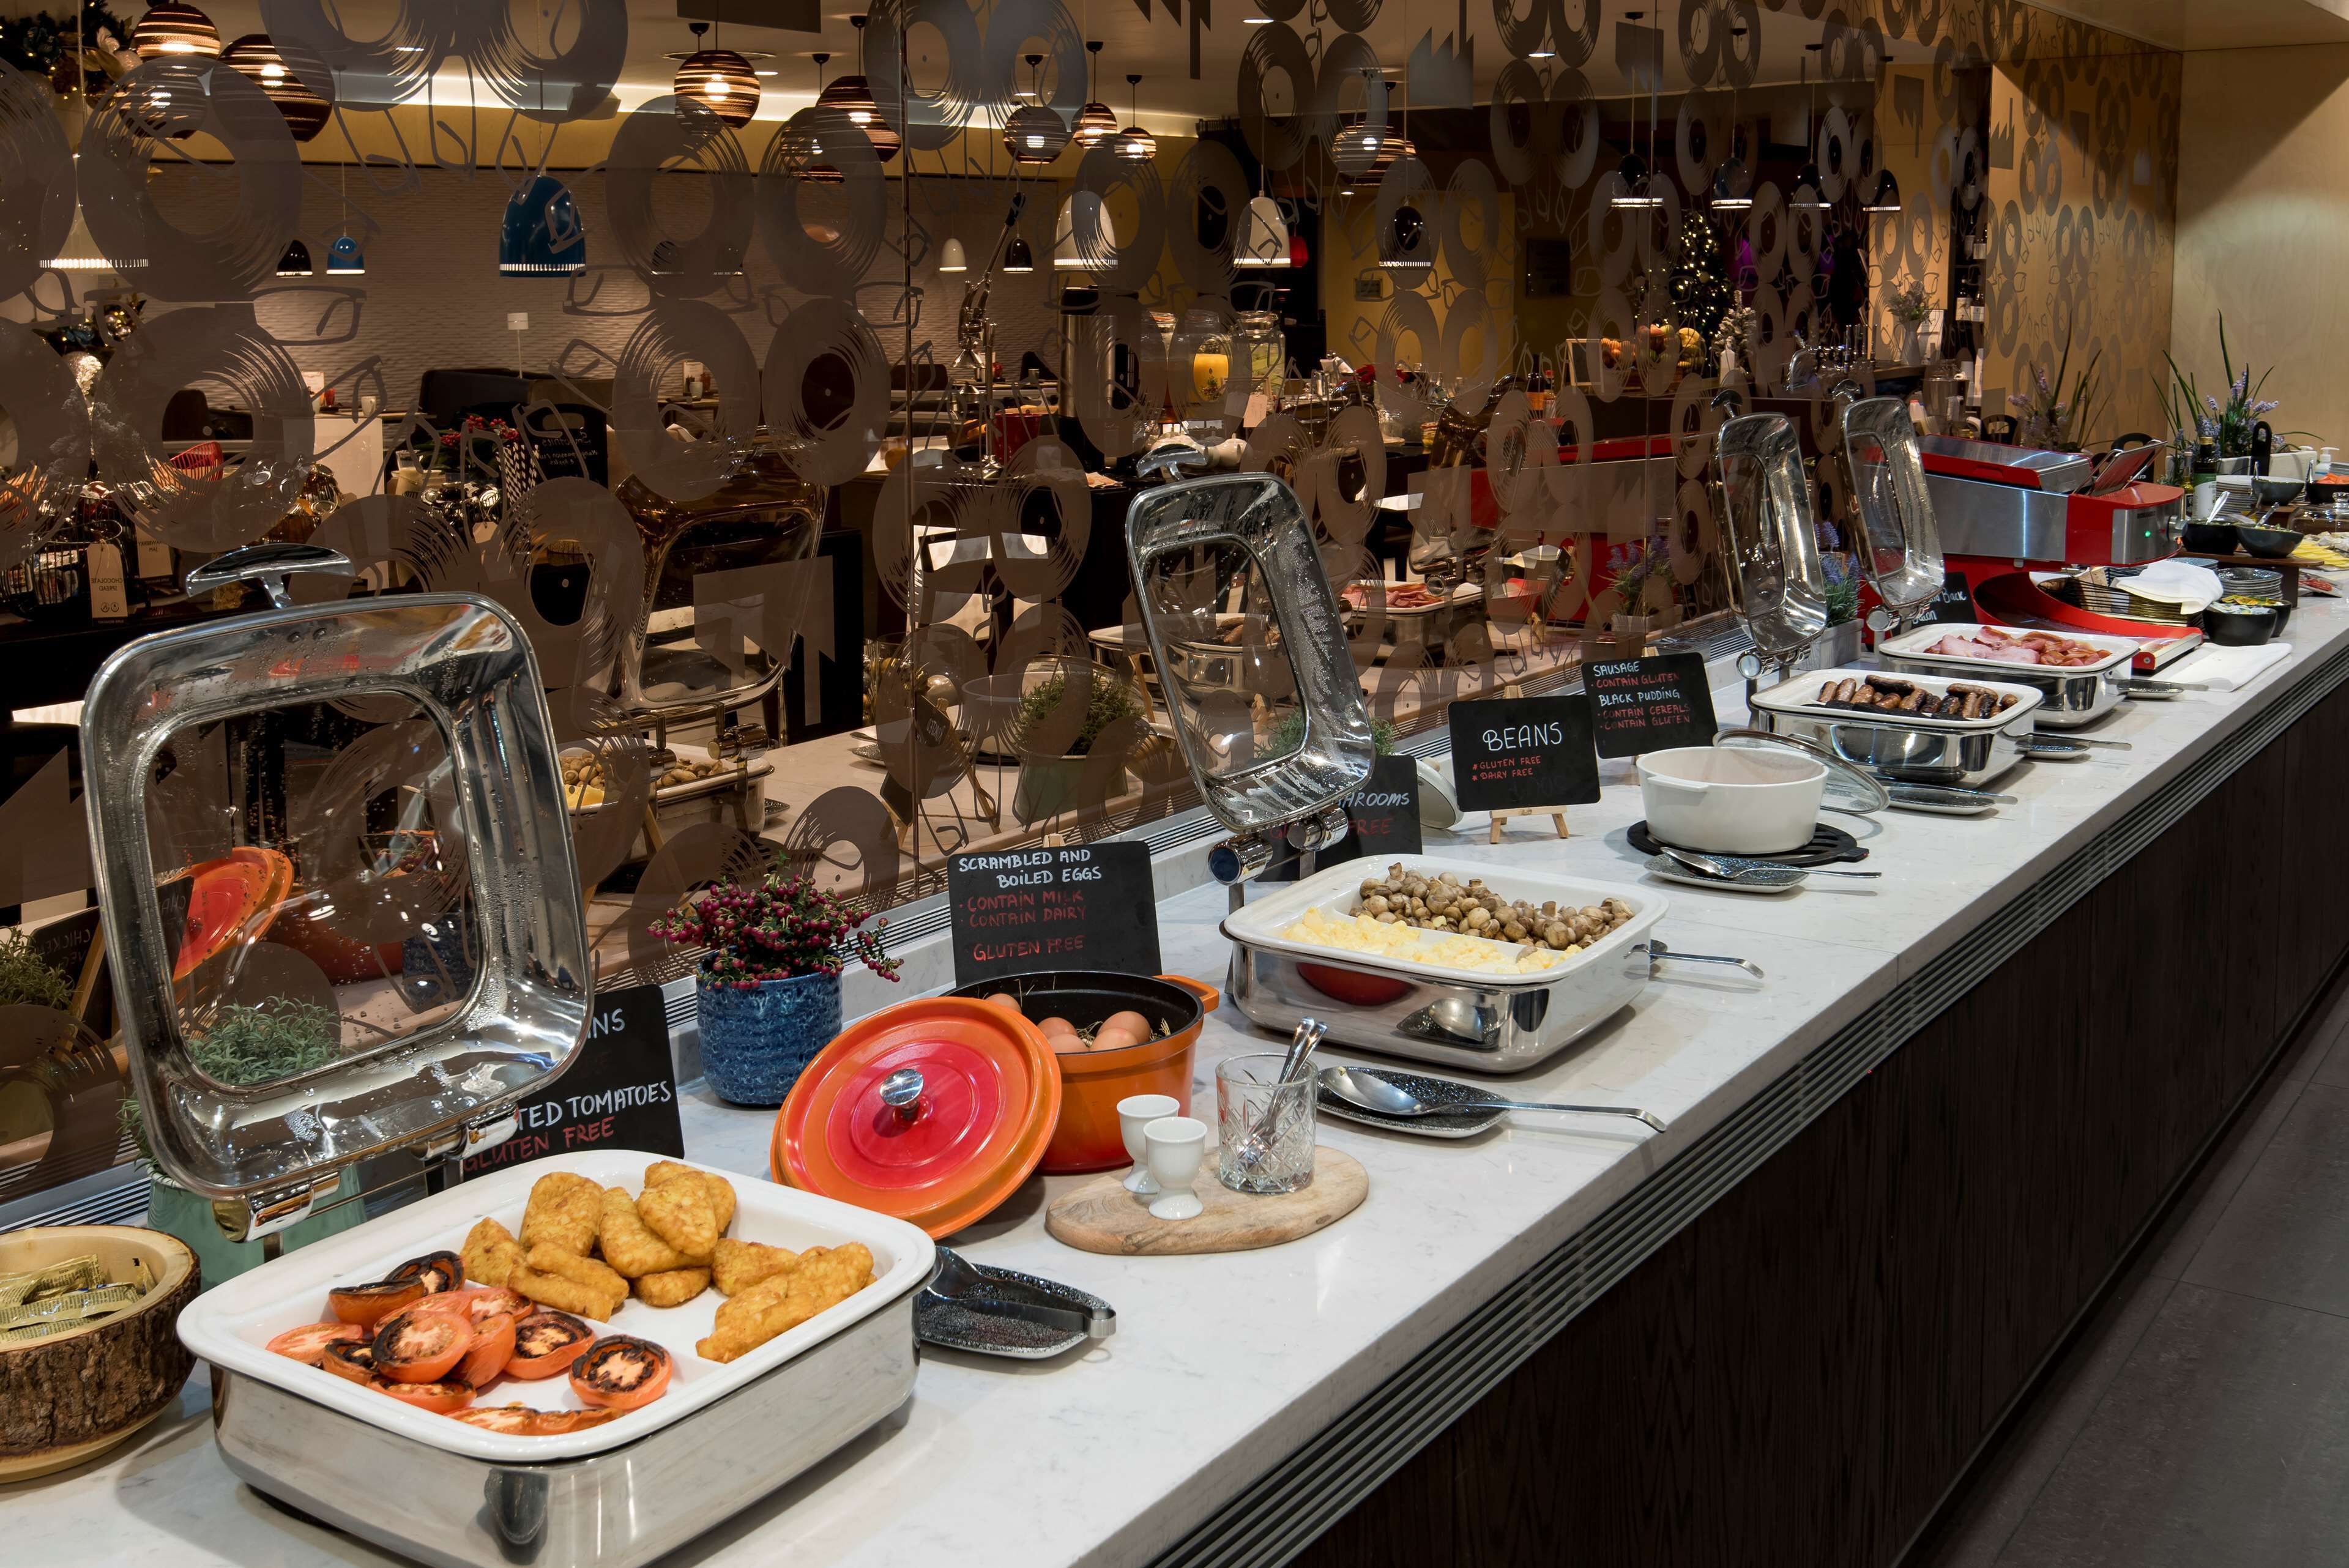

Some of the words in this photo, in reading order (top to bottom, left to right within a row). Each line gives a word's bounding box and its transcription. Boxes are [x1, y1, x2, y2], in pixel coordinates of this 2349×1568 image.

[1593, 661, 1640, 677] SAUSAGE
[1641, 672, 1681, 685] GLUTEN
[1599, 693, 1634, 707] BLACK
[1639, 687, 1681, 702] PUDDING
[1649, 704, 1691, 715] CEREALS
[1652, 715, 1691, 726] GLUTEN
[1483, 722, 1562, 751] BEANS
[1480, 757, 1514, 770] GLUTEN
[1520, 756, 1541, 765] FREE
[1480, 770, 1508, 781] DAIRY
[1512, 768, 1533, 778] FREE
[1338, 792, 1410, 808] HROOMS
[1347, 818, 1394, 837] FREE
[959, 851, 1052, 872] SCRAMBLED
[1059, 849, 1091, 863] AND
[1062, 866, 1102, 882] EGGS
[1043, 890, 1084, 906] MILK
[969, 909, 1037, 929] CONTAIN
[1043, 905, 1087, 921] DAIRY
[973, 939, 1040, 962] GLUTEN
[1046, 934, 1087, 954] FREE
[565, 1080, 672, 1119] TOMATOES
[463, 1132, 549, 1173] GLUTEN
[562, 1115, 616, 1149] FREE
